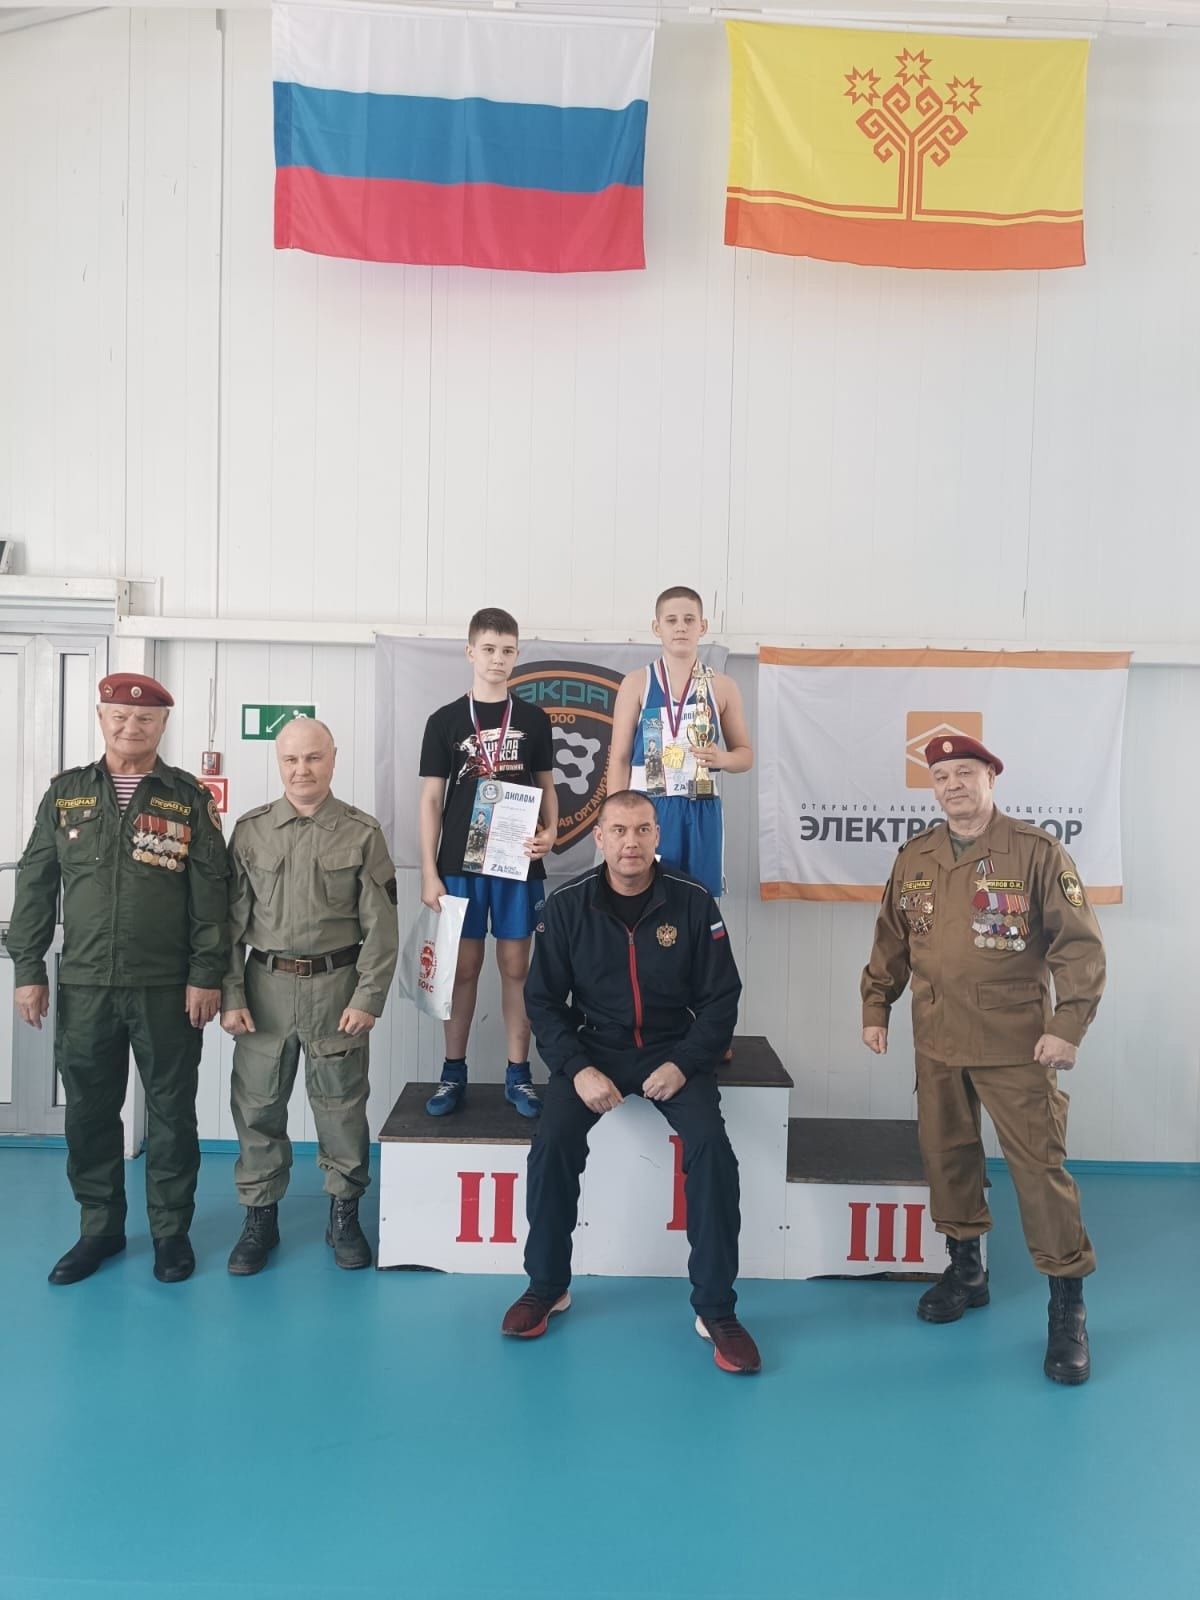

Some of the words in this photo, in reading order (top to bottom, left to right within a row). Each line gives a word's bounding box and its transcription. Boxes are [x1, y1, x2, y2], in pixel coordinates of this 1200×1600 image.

[550, 713, 576, 724] ООО
[58, 799, 95, 807] СПЕЦНАЗ
[504, 791, 535, 804] ДИПЛОМ
[801, 803, 877, 812] ОТКРЫТОЕ
[1005, 806, 1084, 814] ОБЩЕСТВО
[800, 815, 1083, 845] ЭЛЕКТРОР
[456, 1171, 518, 1243] II
[847, 1202, 925, 1263] III
